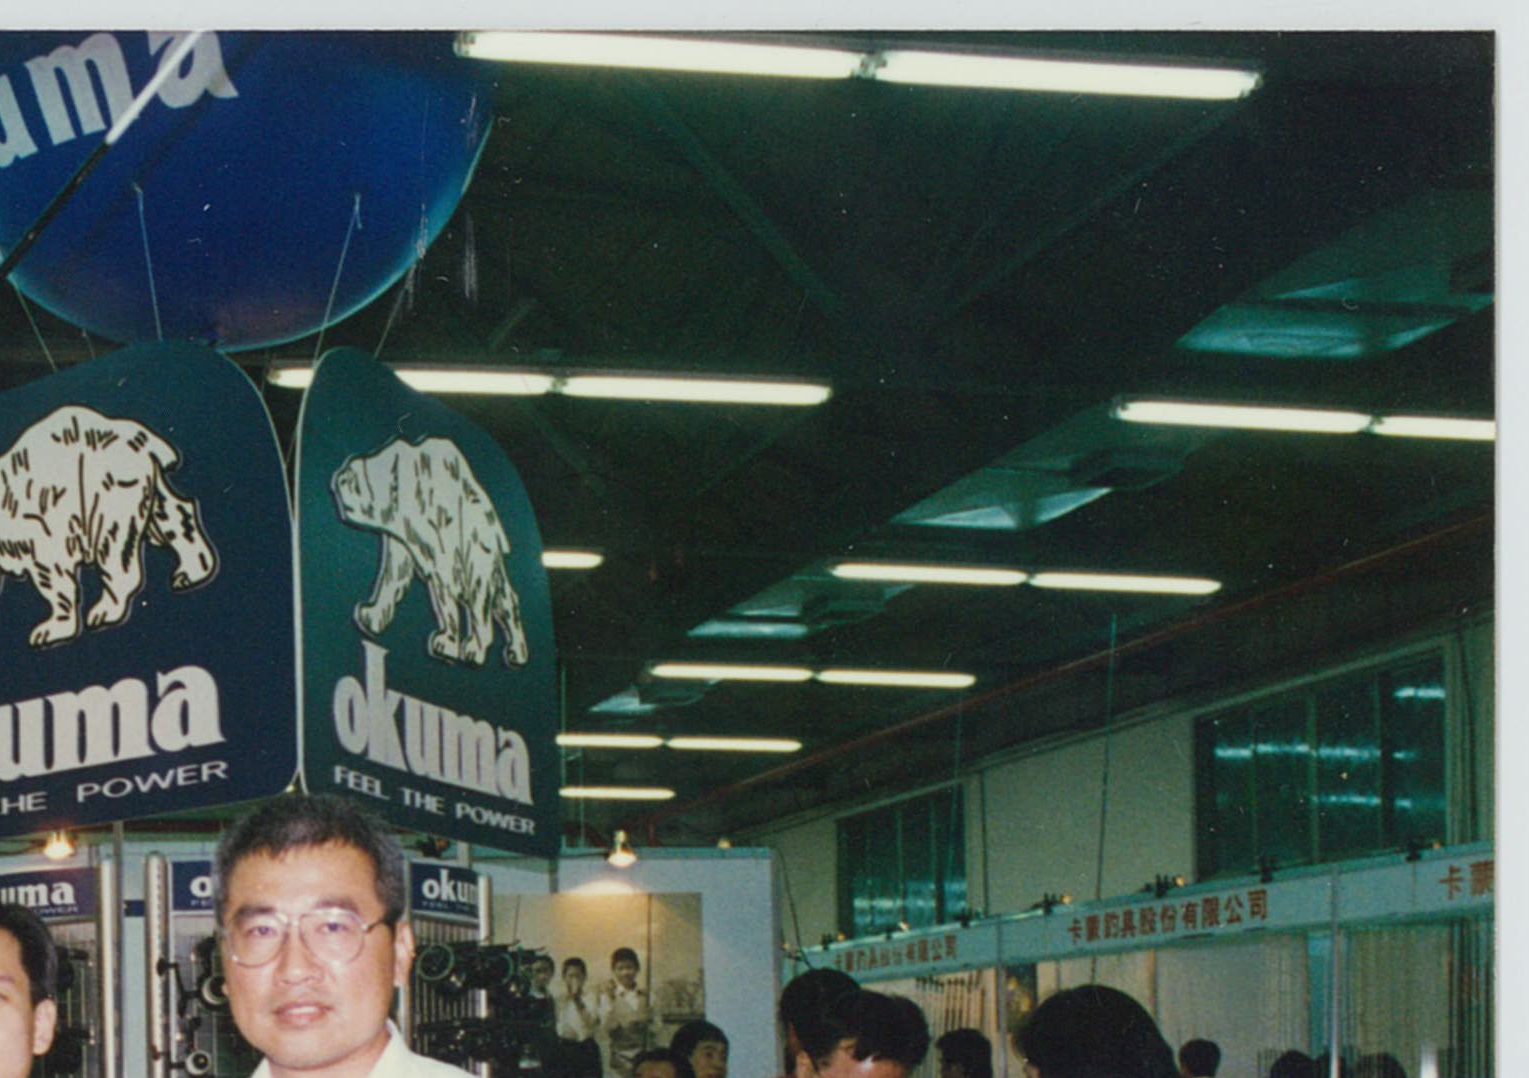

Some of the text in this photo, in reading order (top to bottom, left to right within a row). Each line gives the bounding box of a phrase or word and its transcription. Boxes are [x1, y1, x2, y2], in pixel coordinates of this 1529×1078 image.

[334, 640, 534, 805] okuma
[77, 761, 229, 803] POWER
[334, 765, 536, 836] FEEL THE POWER
